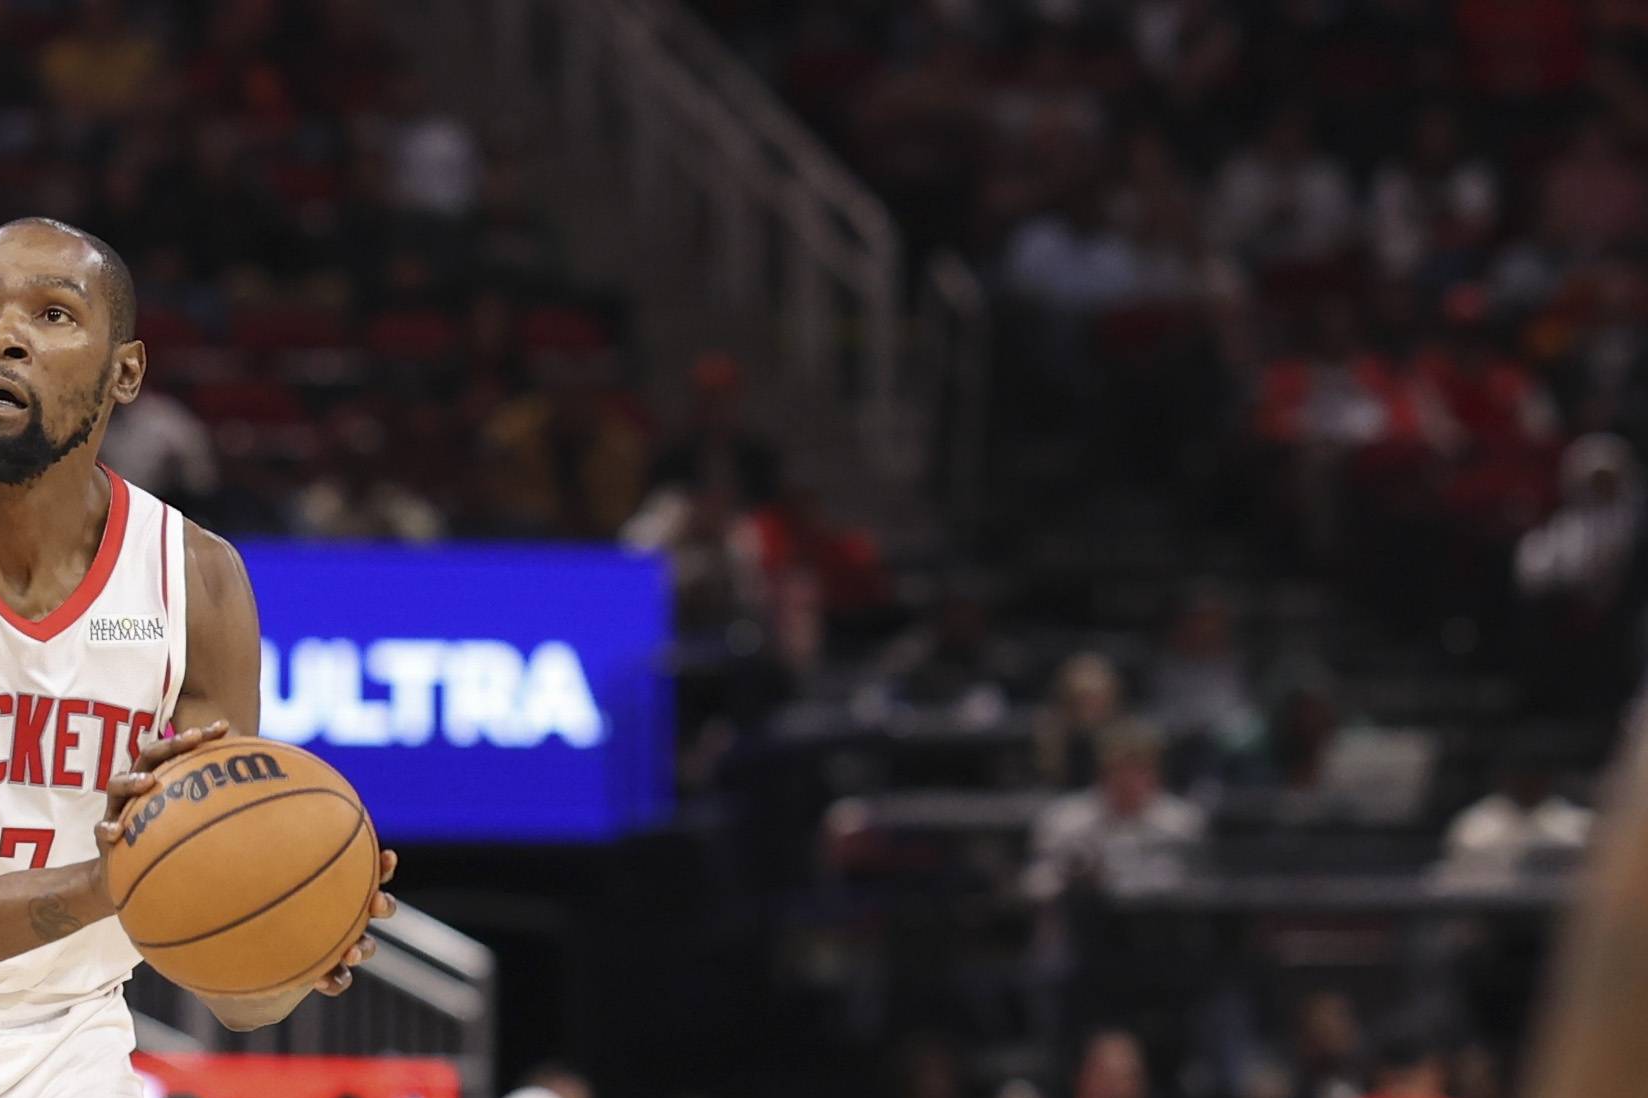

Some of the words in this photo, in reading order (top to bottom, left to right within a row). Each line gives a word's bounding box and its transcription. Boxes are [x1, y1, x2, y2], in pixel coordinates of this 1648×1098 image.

[89, 617, 163, 630] MEMORIAL
[89, 629, 164, 641] HERMANN
[260, 637, 604, 749] ULTRA
[123, 751, 289, 848] Wilson
